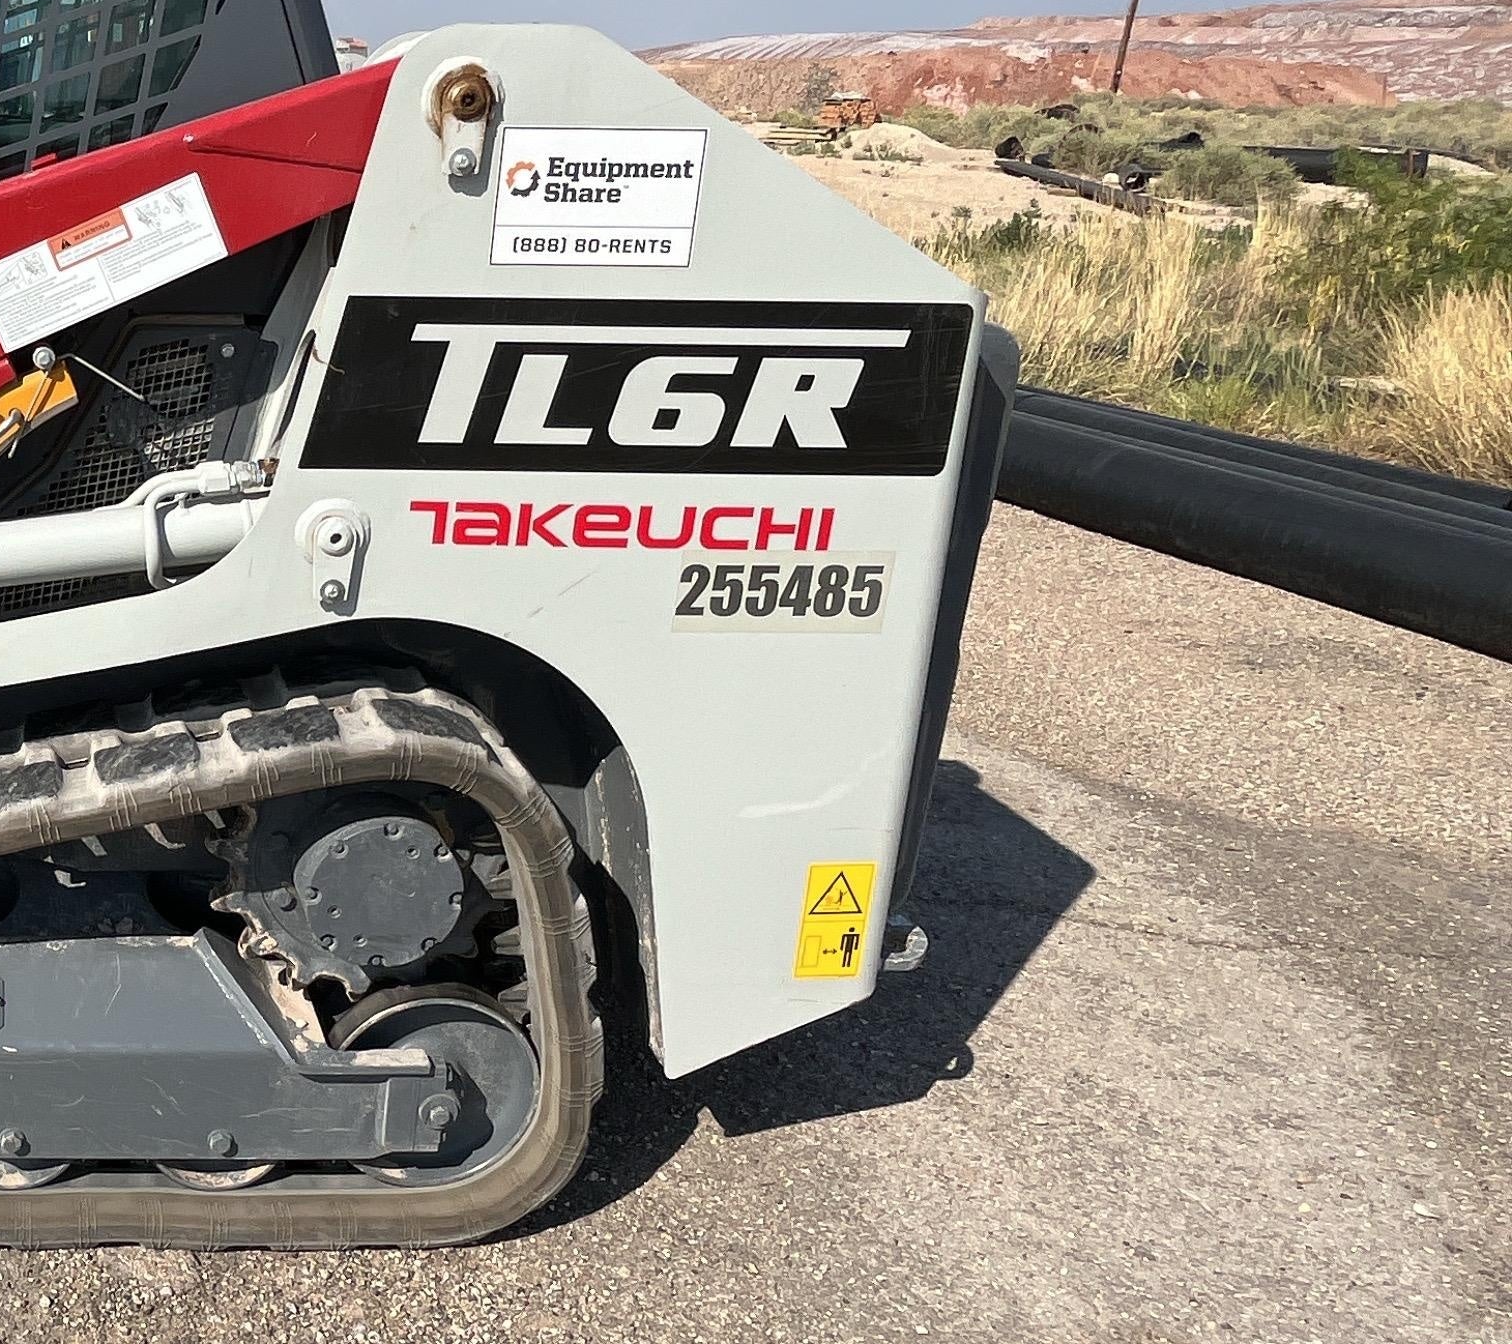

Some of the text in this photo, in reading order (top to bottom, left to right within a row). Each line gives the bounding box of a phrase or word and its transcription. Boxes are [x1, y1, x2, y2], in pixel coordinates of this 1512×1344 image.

[546, 156, 695, 183] Equipment
[543, 182, 623, 204] Share
[73, 220, 111, 241] WARNING
[512, 236, 673, 254] (888) 80-RENTS
[410, 323, 912, 449] TL6R
[410, 500, 835, 552] TAKEUCHI
[674, 563, 885, 618] 255485
